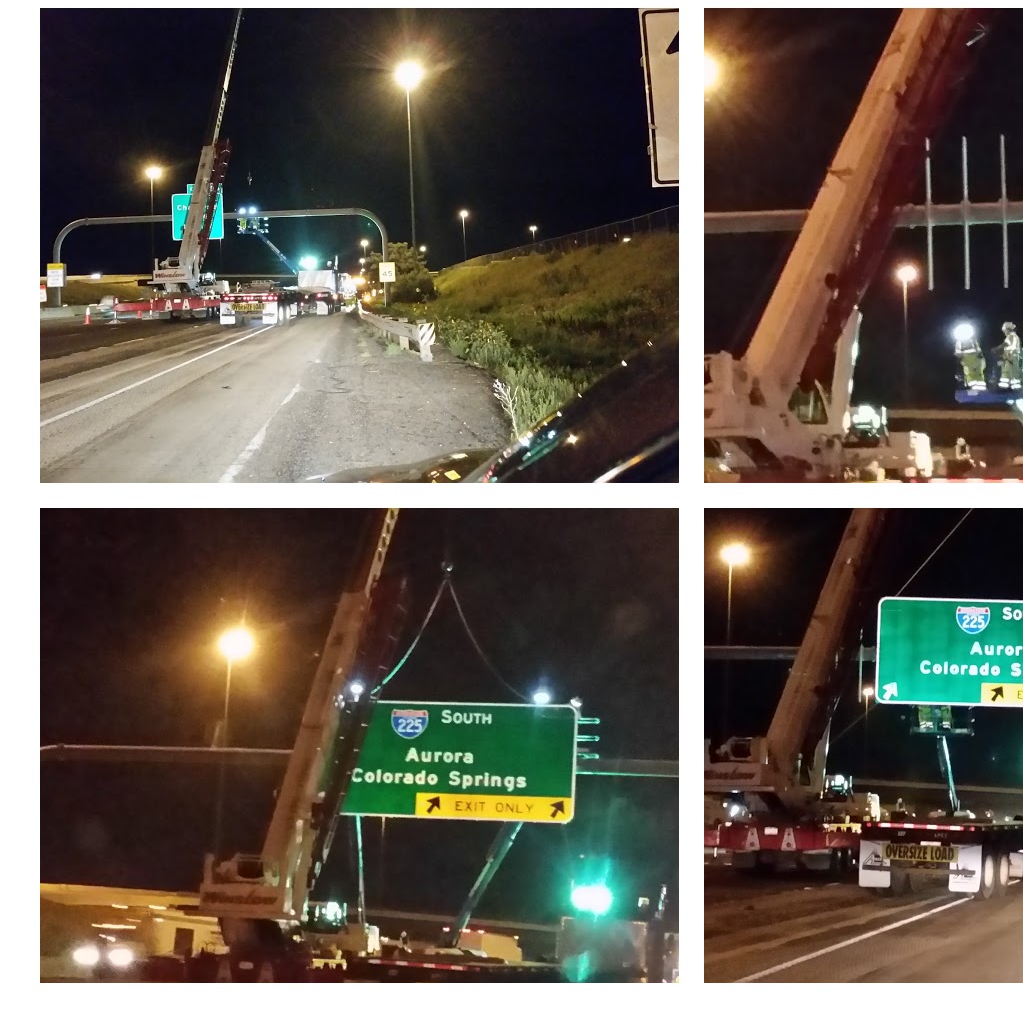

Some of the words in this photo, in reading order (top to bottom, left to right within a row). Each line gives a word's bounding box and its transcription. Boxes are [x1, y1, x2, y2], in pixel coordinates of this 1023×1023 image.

[962, 615, 985, 629] 225
[919, 659, 1000, 676] Colorado
[397, 718, 423, 733] 225
[405, 747, 474, 764] Aurora
[351, 769, 438, 785] Colorado
[448, 776, 527, 792] Springs
[455, 800, 485, 812] EXIT
[495, 802, 534, 814] ONLY
[885, 845, 927, 859] OVERSIZE
[930, 846, 954, 861] LOAD
